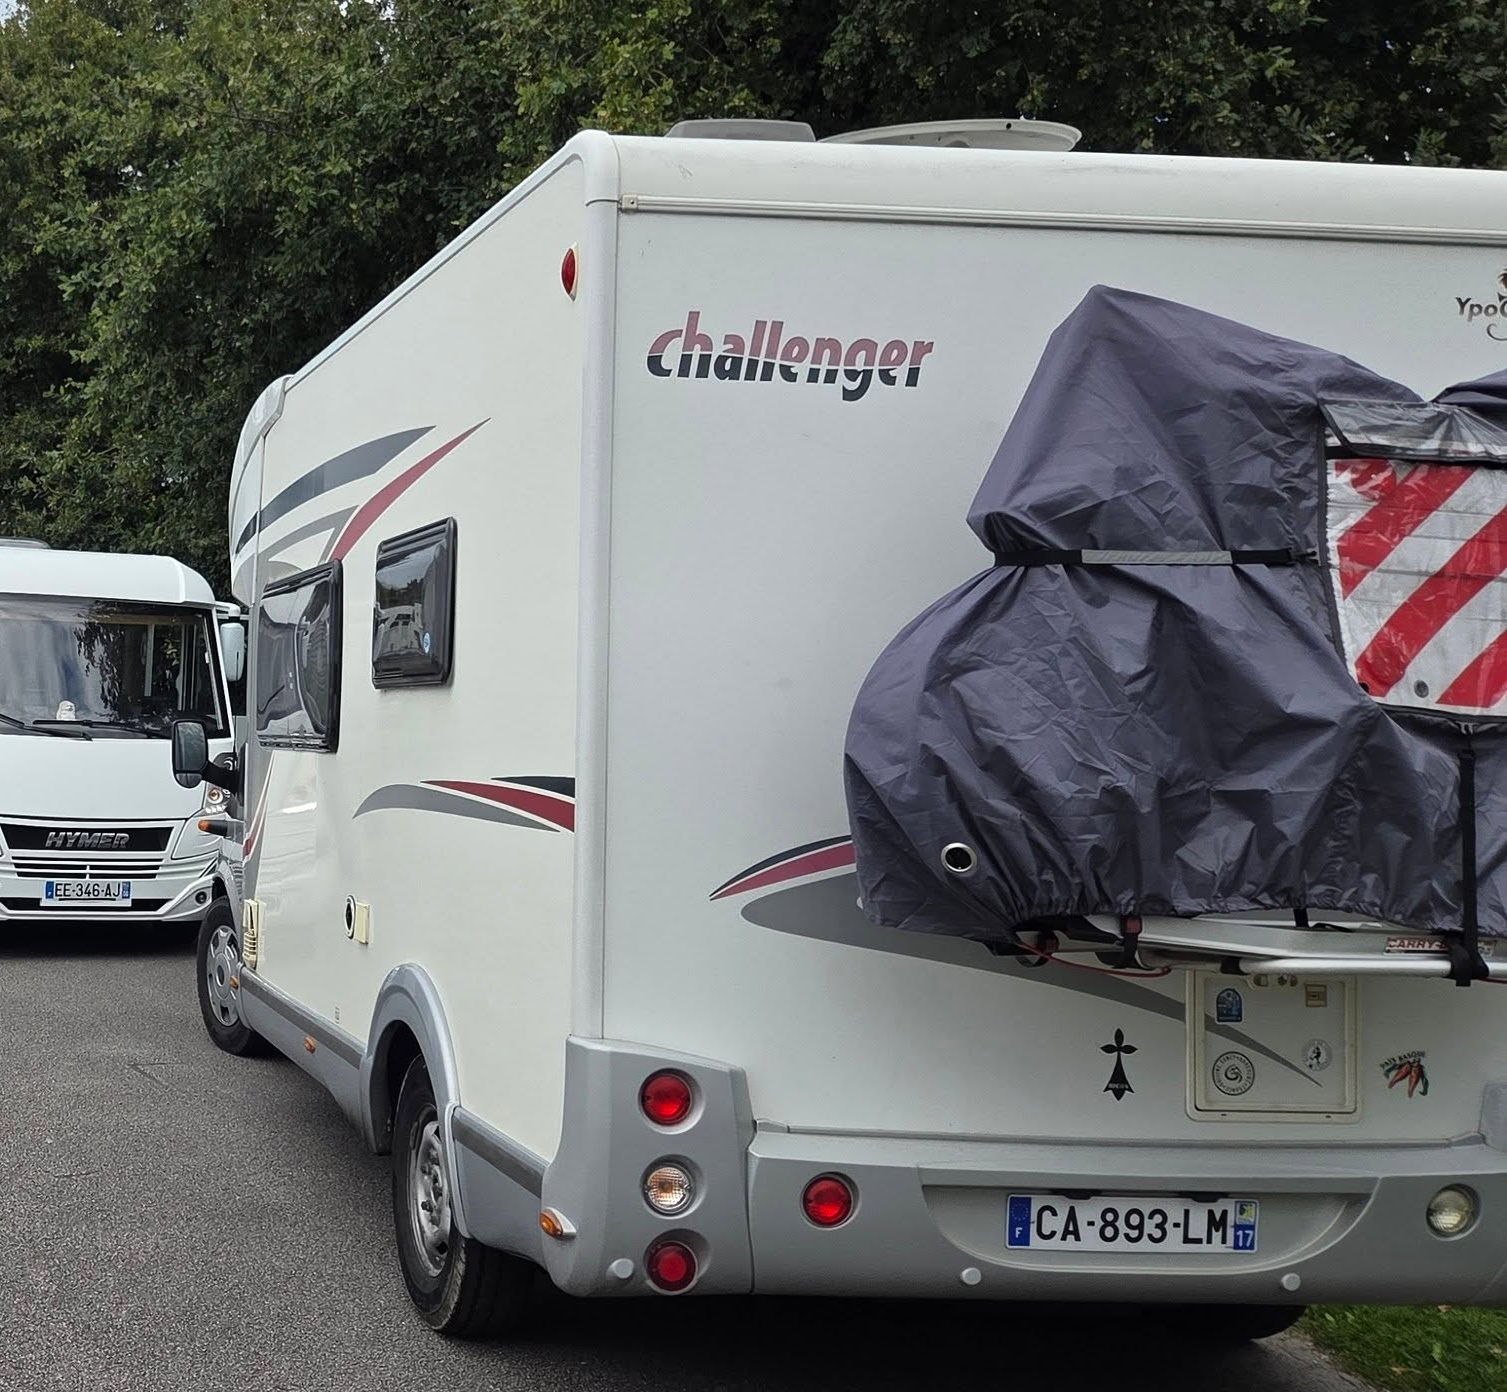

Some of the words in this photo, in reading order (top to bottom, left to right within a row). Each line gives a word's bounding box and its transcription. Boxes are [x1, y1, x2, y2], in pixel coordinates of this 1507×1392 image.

[646, 311, 934, 402] challenger
[45, 831, 130, 848] HYMER
[54, 882, 121, 897] EE-346-AJ
[1015, 1227, 1023, 1239] F
[1035, 1204, 1229, 1245] CA-893-LM
[1236, 1230, 1254, 1247] 17
